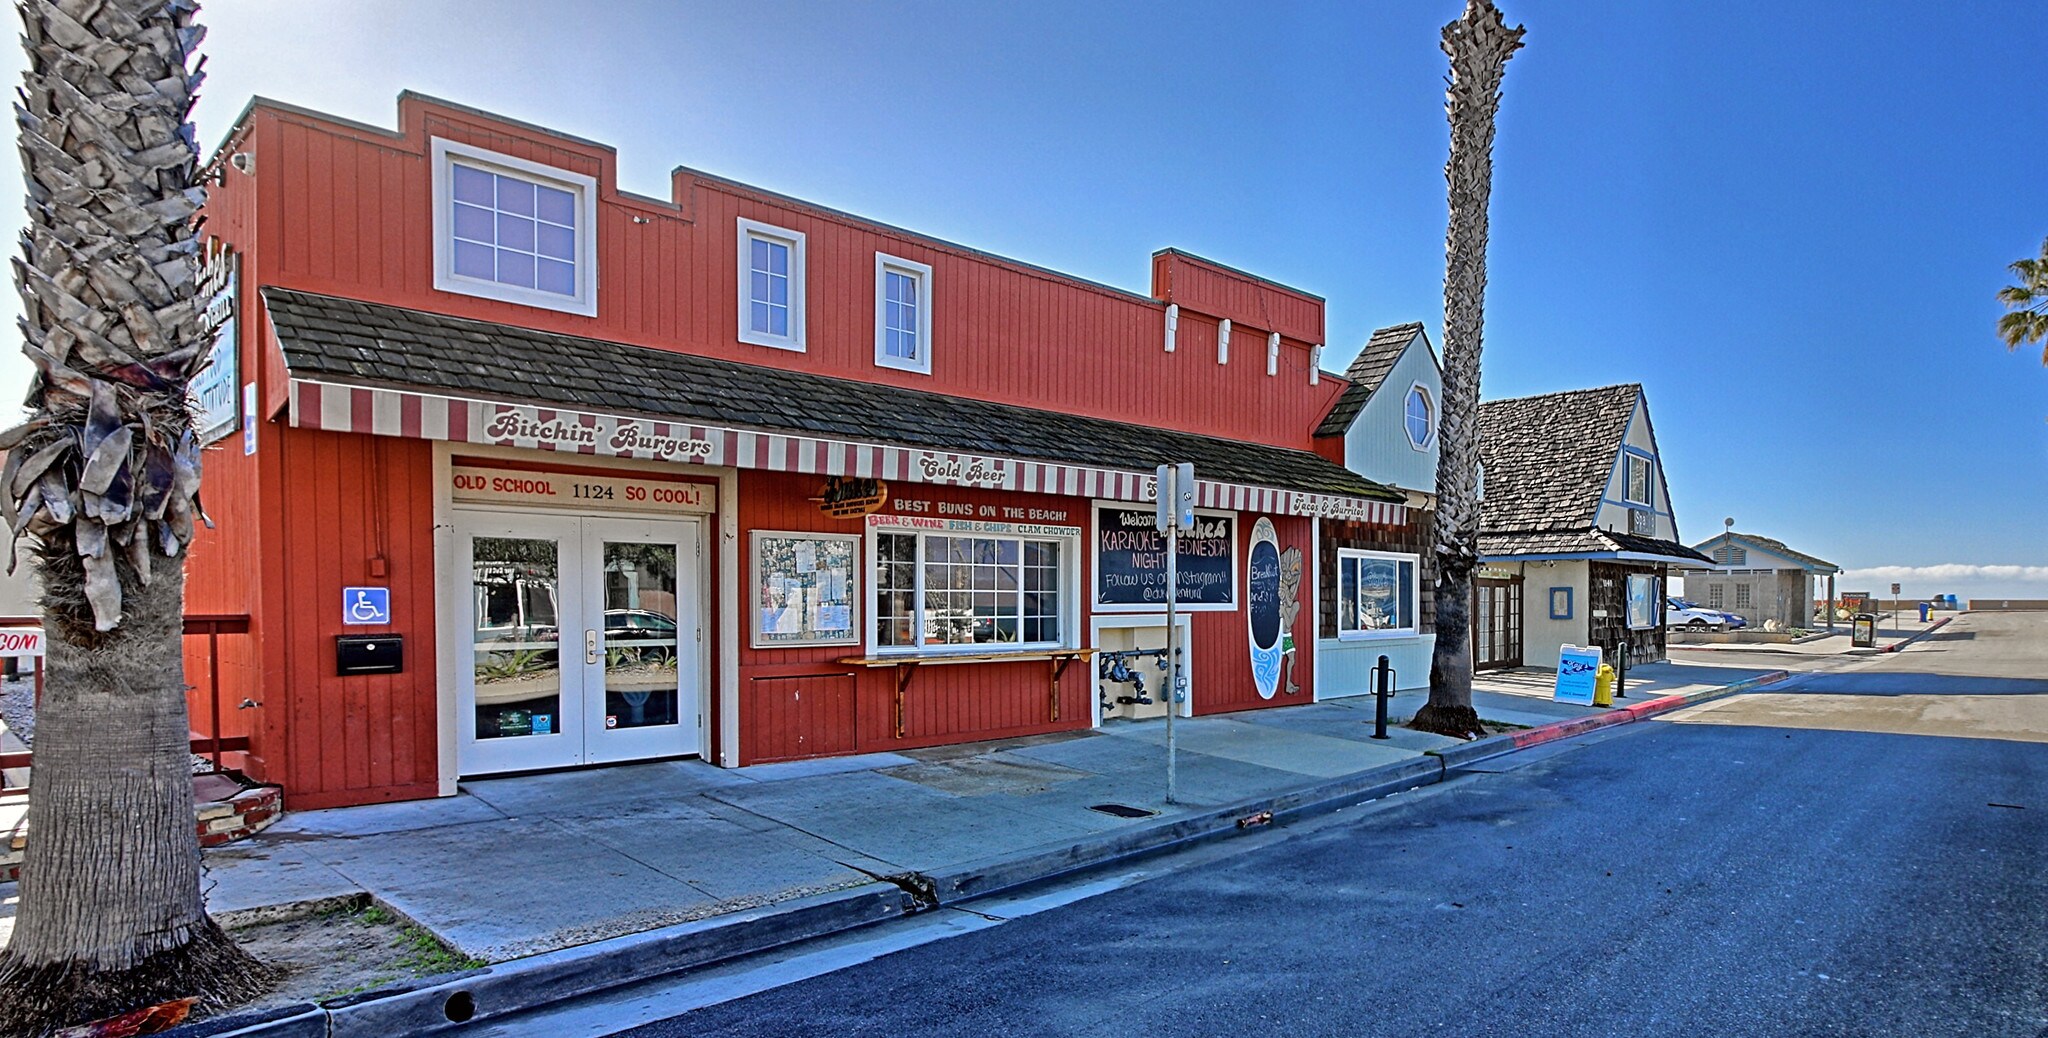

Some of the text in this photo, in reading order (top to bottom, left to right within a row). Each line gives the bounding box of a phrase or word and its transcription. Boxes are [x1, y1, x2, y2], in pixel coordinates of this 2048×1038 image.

[487, 413, 711, 456] Bitchin' Burgers
[920, 458, 1005, 481] Cold Beer
[453, 474, 556, 495] OLD SCHOOL
[573, 484, 614, 500] 1124
[626, 486, 700, 505] SO COOL!
[894, 499, 931, 512] BEST
[938, 502, 973, 515] BUNS
[979, 505, 996, 517] ON
[1003, 507, 1025, 519] THE
[1028, 508, 1067, 521] BEACH!
[1294, 498, 1364, 516] Tacos & Burritos
[902, 516, 909, 526] &
[949, 520, 1011, 532] FISH & CHIPS
[1119, 511, 1156, 527] Welcom
[1018, 525, 1080, 536] CLAM CHOWDER
[1101, 530, 1160, 552] KARAOKE
[1177, 538, 1231, 557] EDNESDAY
[1132, 552, 1168, 569] NIGHT
